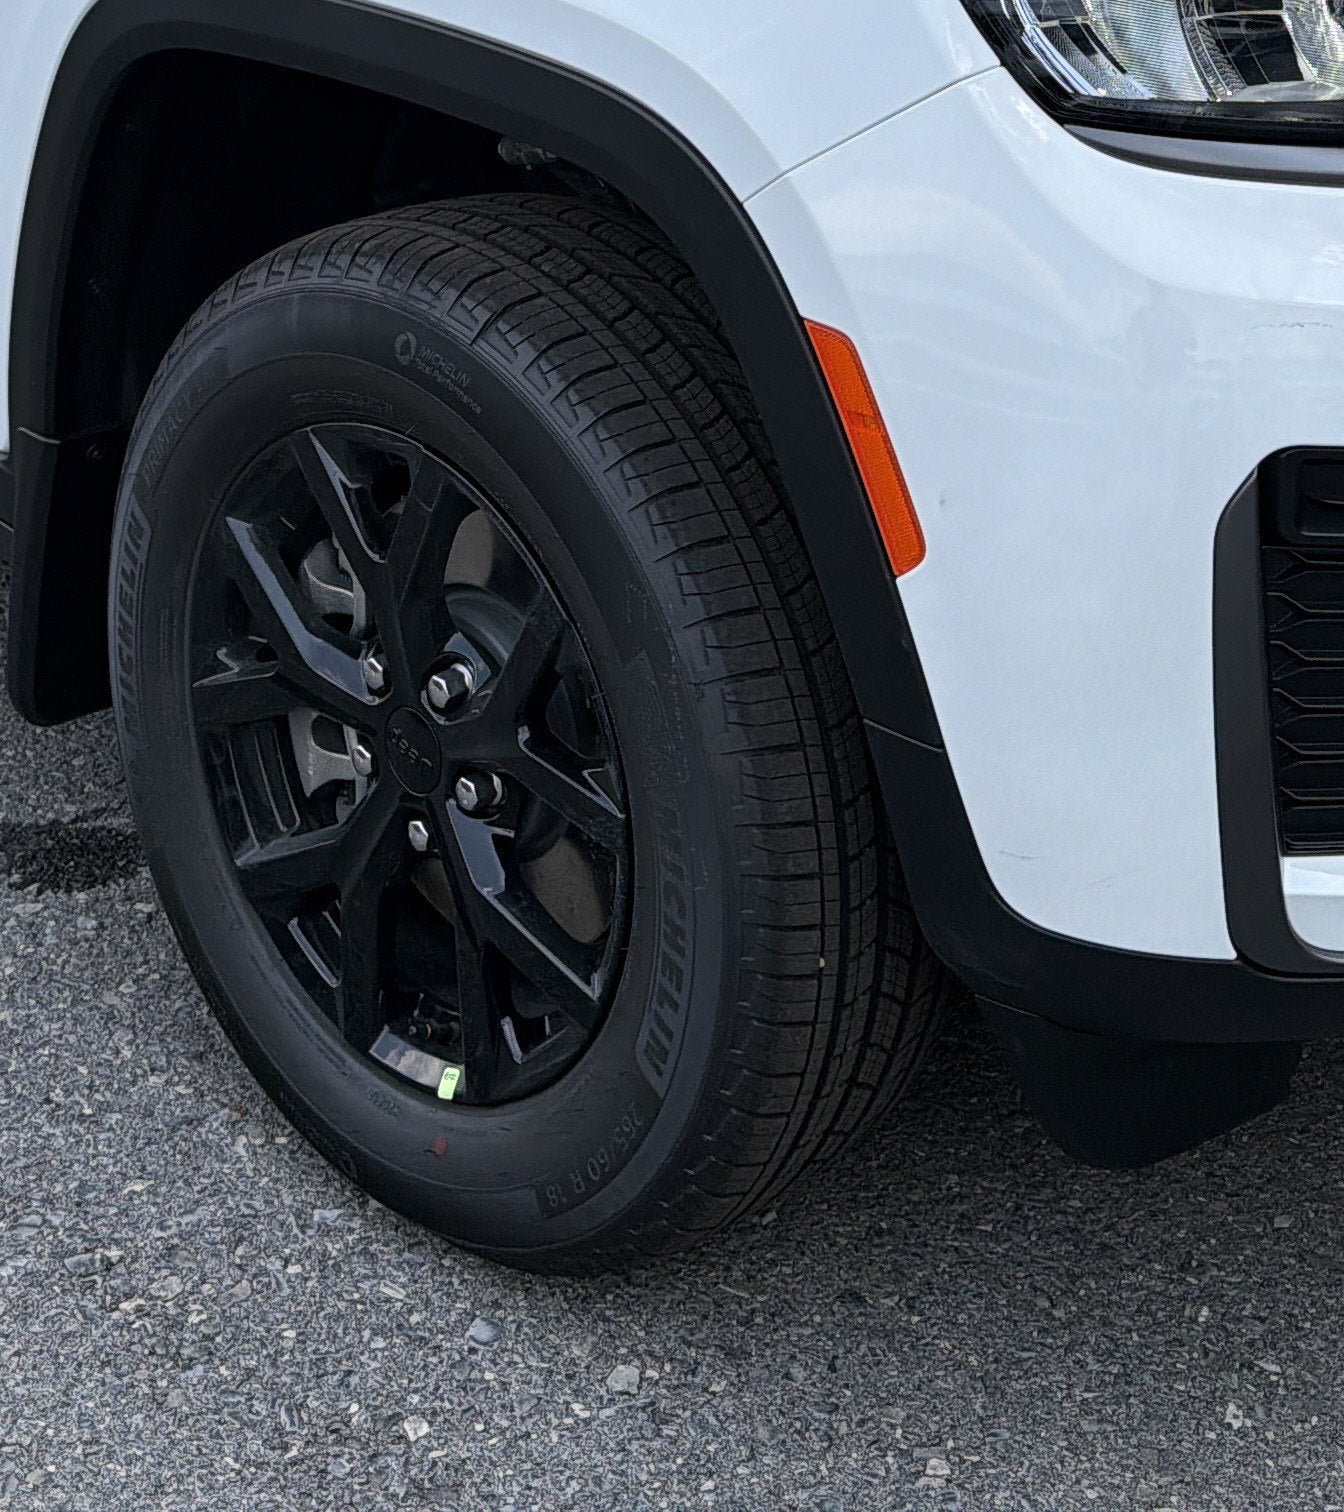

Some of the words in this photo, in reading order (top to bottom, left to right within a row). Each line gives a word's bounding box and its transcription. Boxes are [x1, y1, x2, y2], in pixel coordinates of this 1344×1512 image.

[418, 345, 472, 388] MICHELIN
[568, 1168, 586, 1195] R
[545, 1182, 568, 1209] 18
